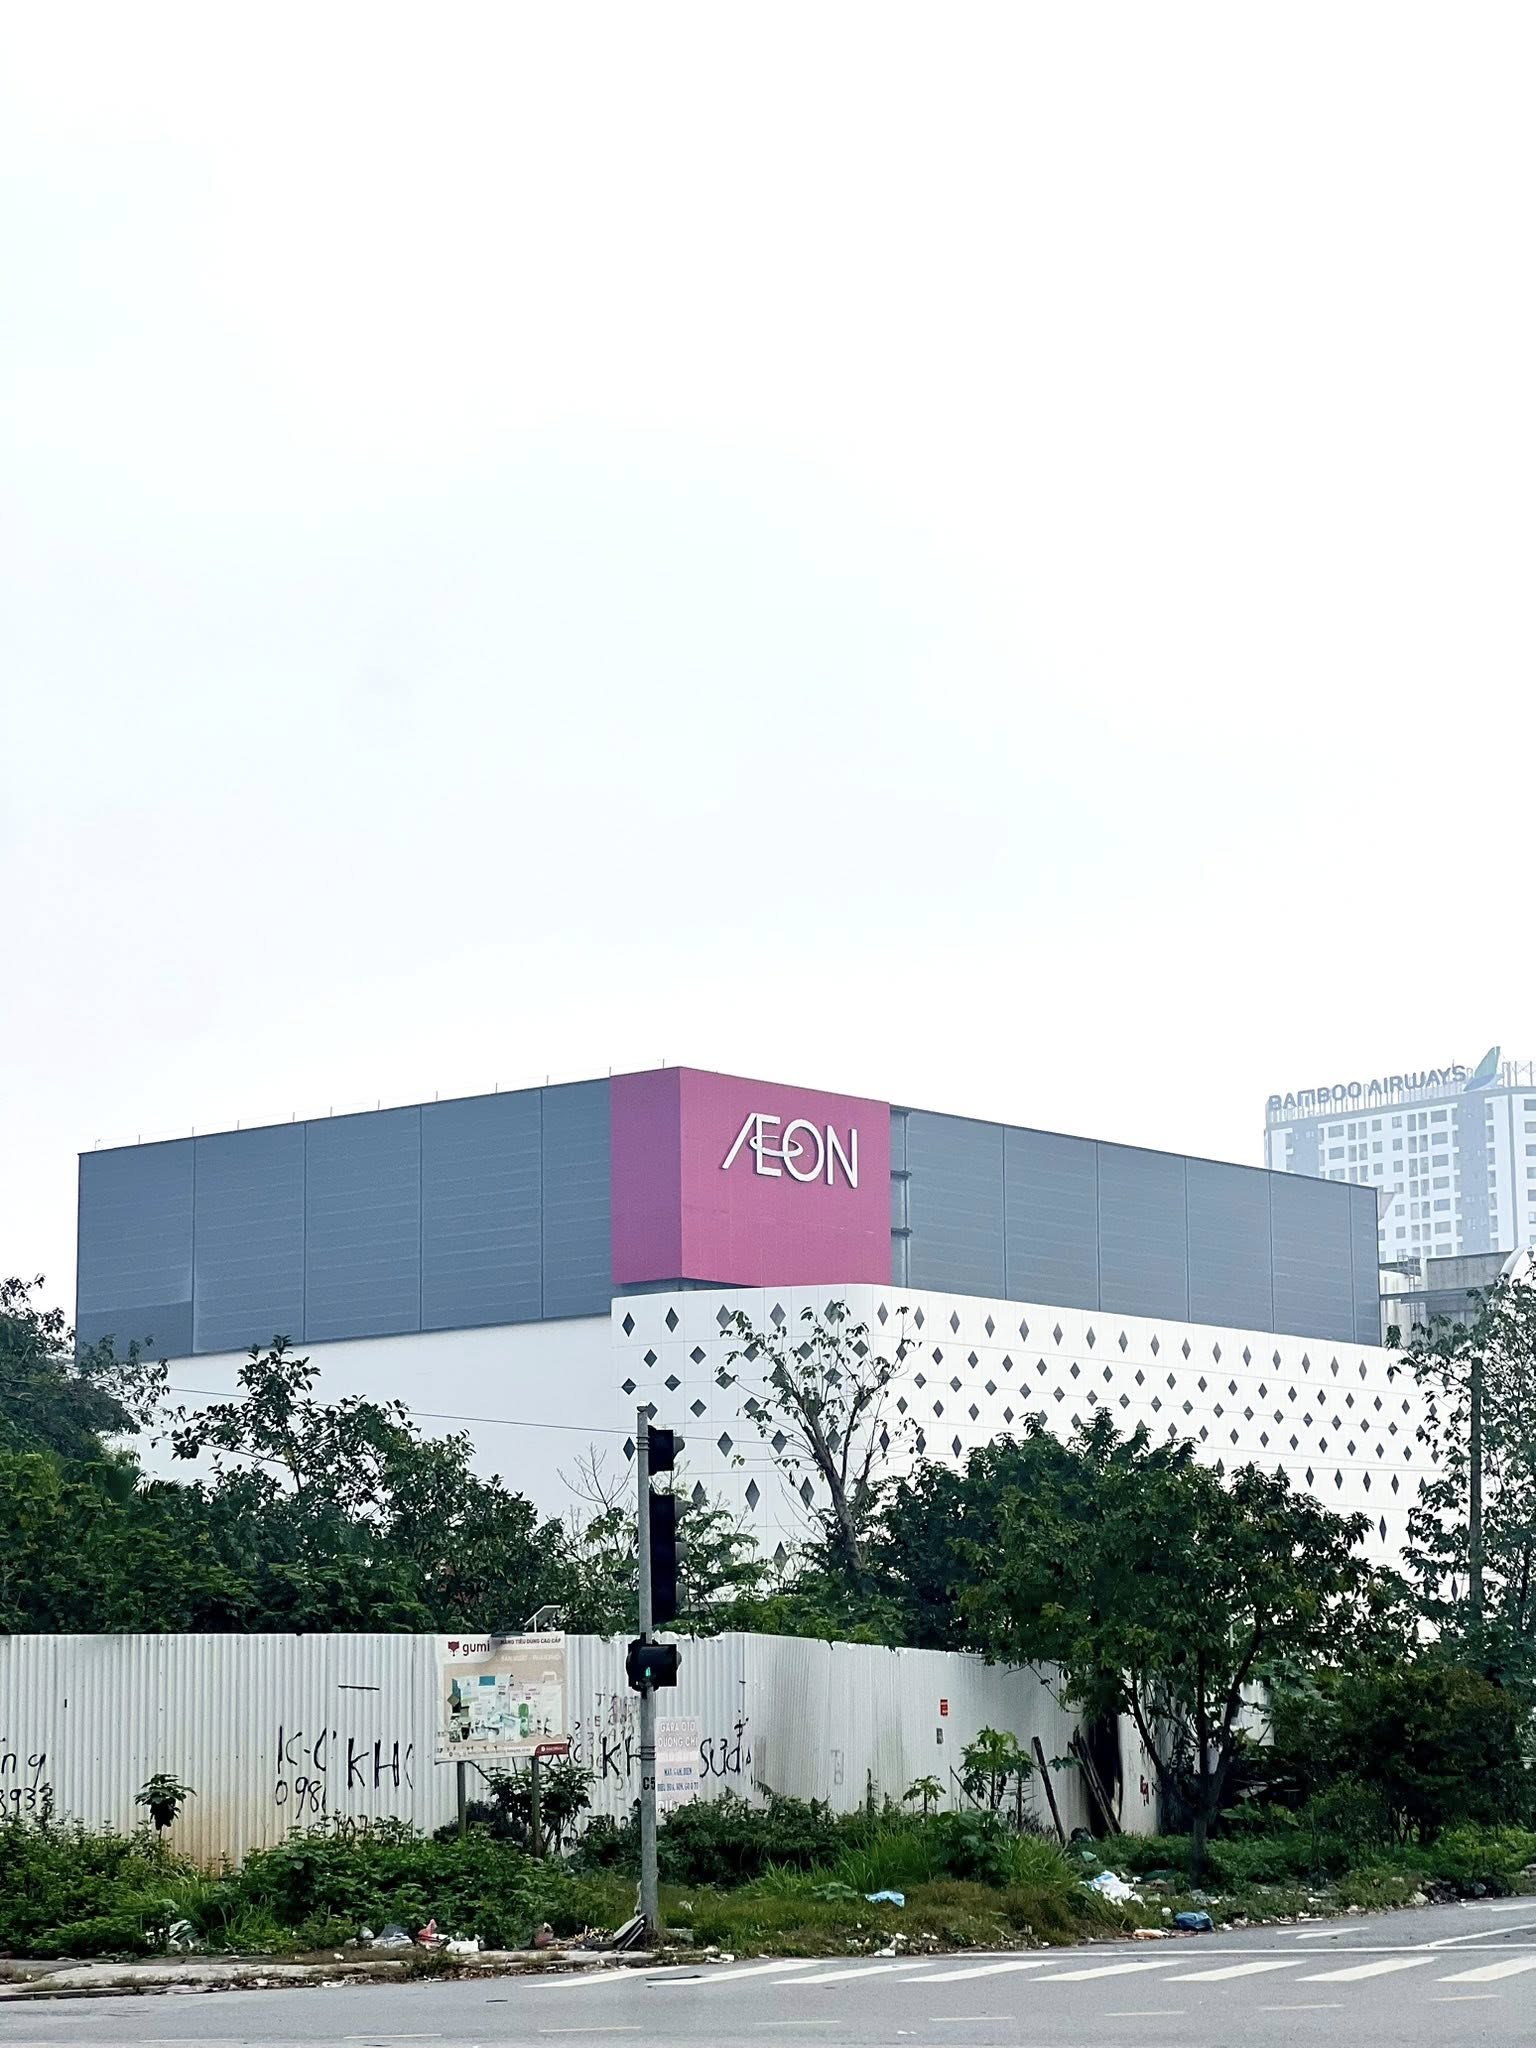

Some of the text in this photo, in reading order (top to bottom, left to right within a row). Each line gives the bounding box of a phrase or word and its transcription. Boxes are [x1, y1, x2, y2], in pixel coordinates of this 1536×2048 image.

[1268, 1064, 1467, 1111] BAMBOO AIRWAYS
[462, 1640, 490, 1657] gumi
